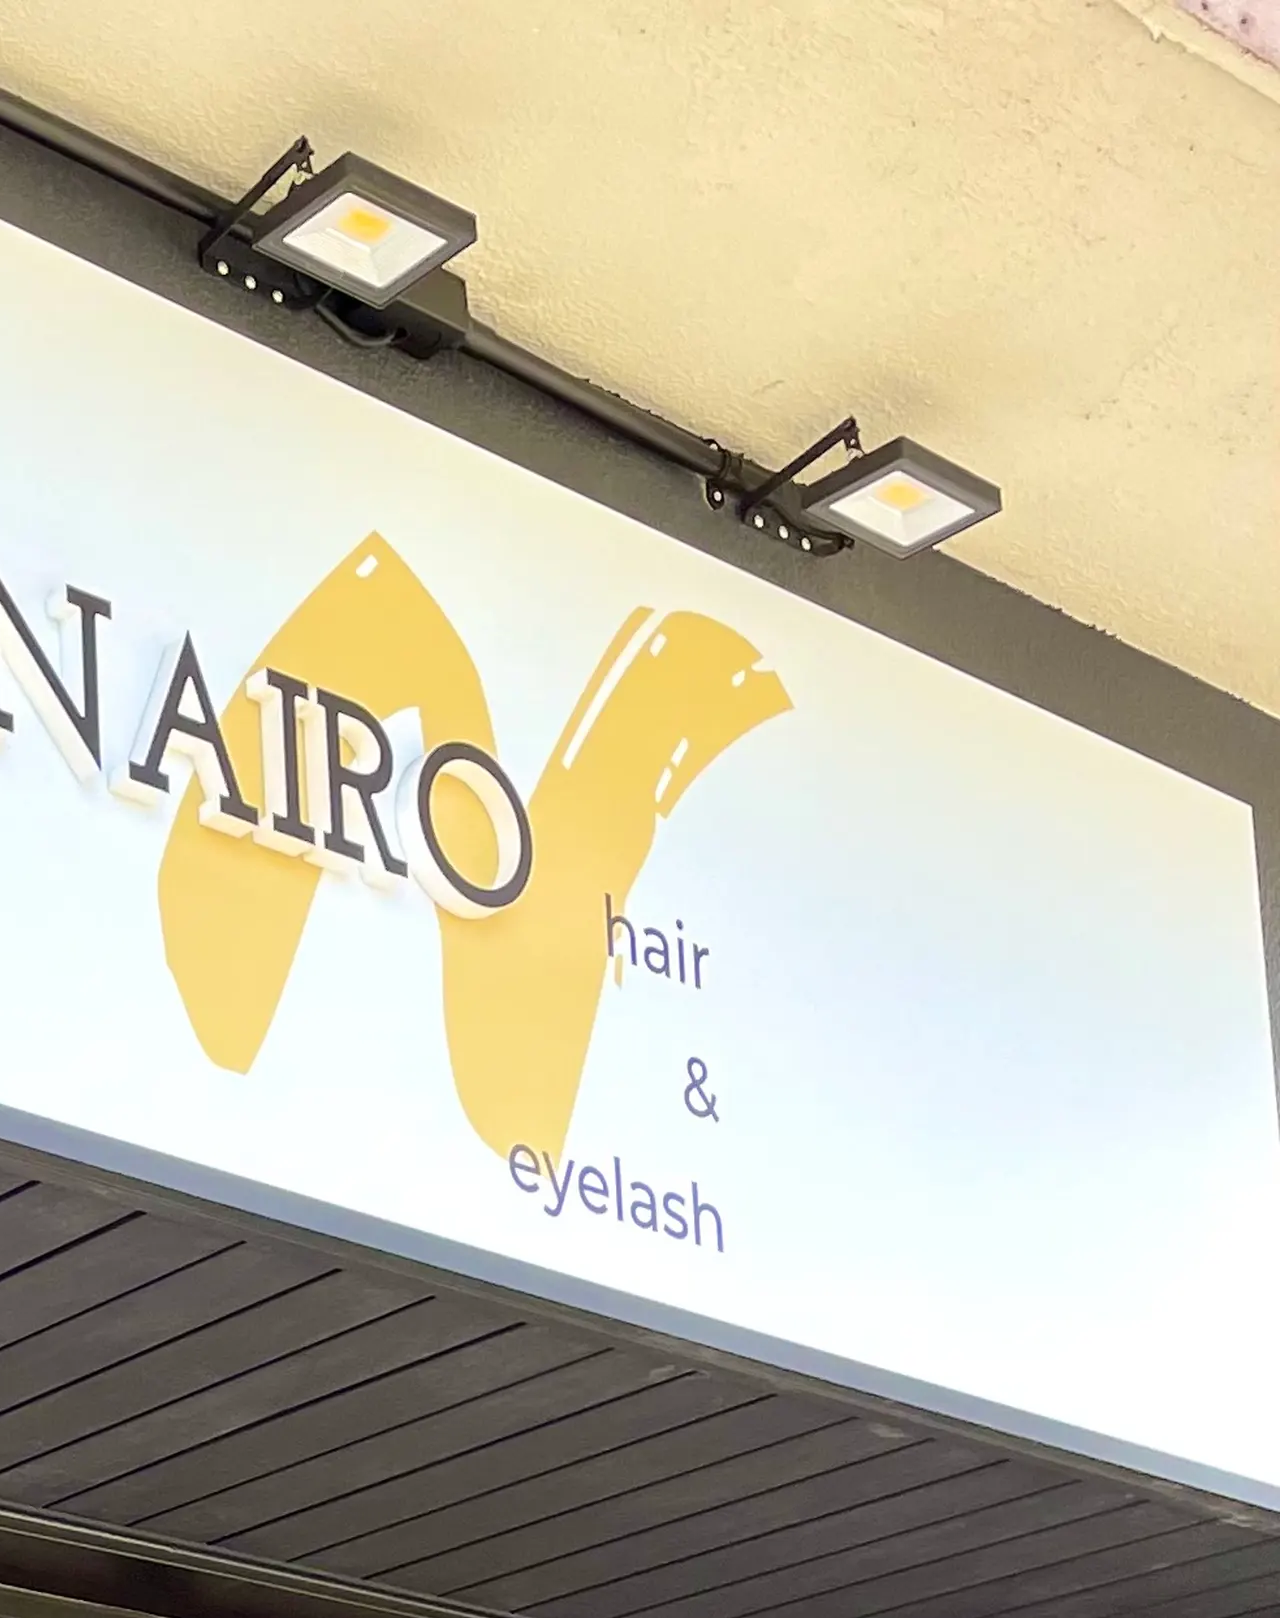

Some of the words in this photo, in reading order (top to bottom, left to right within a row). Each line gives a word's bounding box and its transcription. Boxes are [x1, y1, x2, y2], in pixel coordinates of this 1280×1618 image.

[603, 892, 710, 988] hair
[683, 1057, 720, 1122] &
[509, 1142, 726, 1253] eyelash
